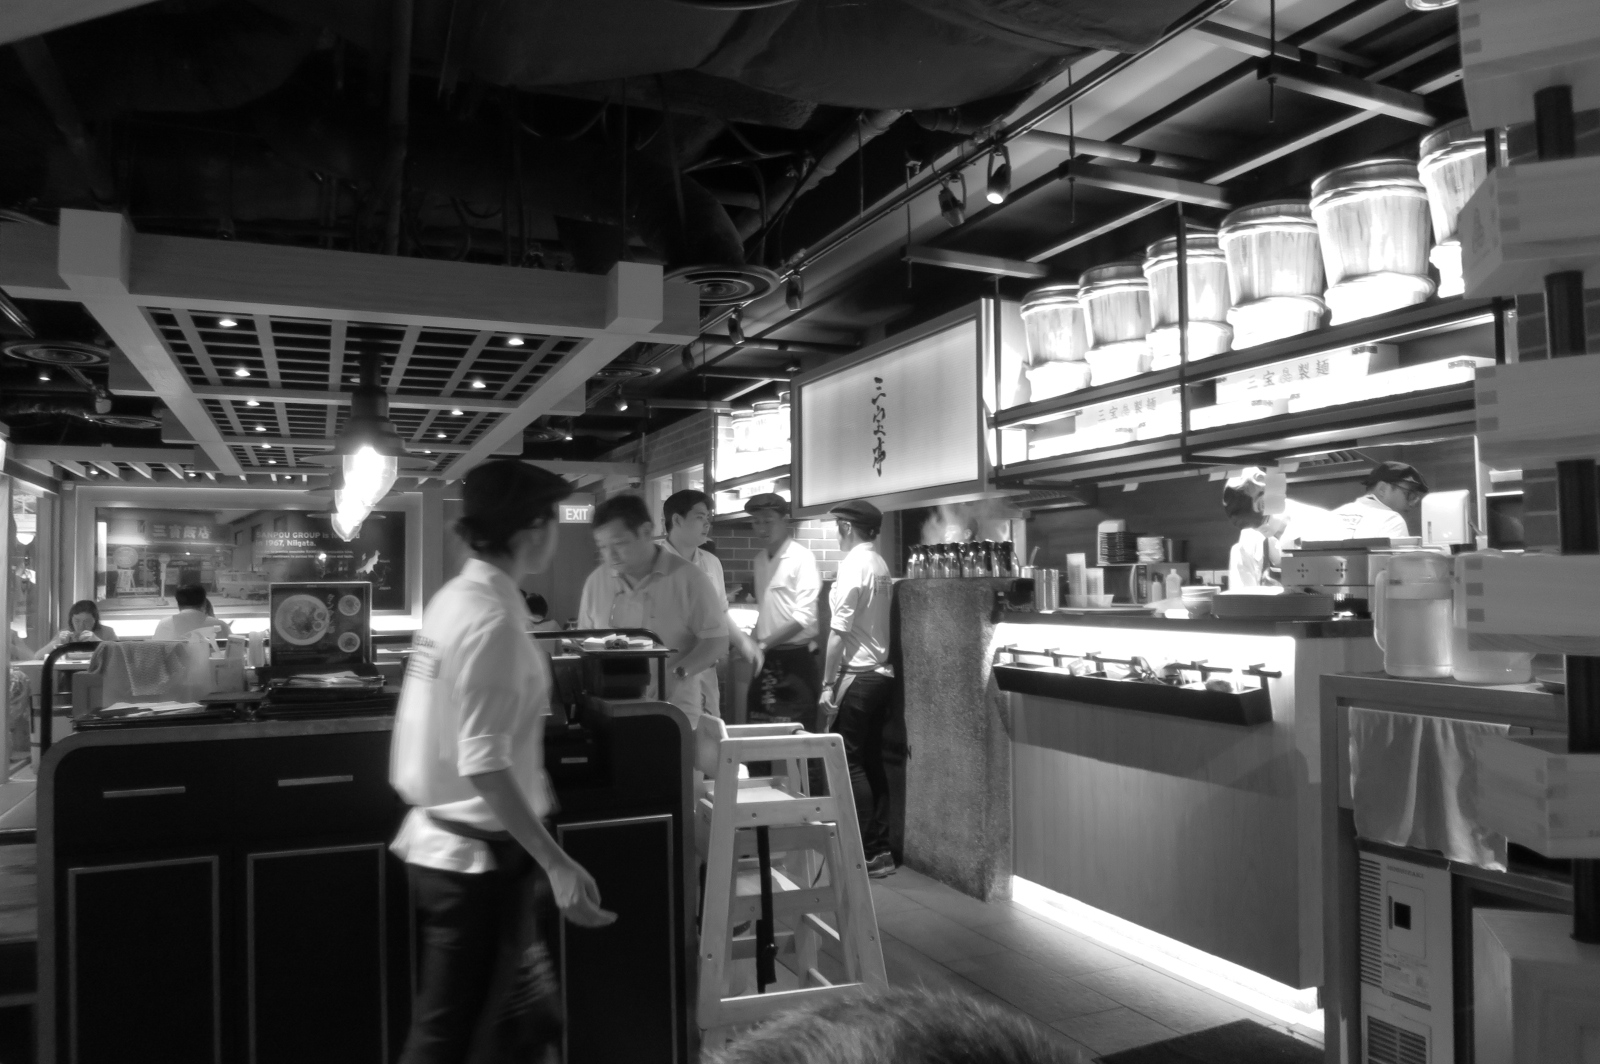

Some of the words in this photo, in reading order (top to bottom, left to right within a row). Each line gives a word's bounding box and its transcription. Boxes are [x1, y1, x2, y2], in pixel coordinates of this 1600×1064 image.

[565, 508, 588, 520] EXIT
[255, 531, 290, 539] SANPOU
[292, 531, 321, 539] GROUP
[265, 539, 285, 547] 1967,
[287, 539, 317, 548] Niigata.
